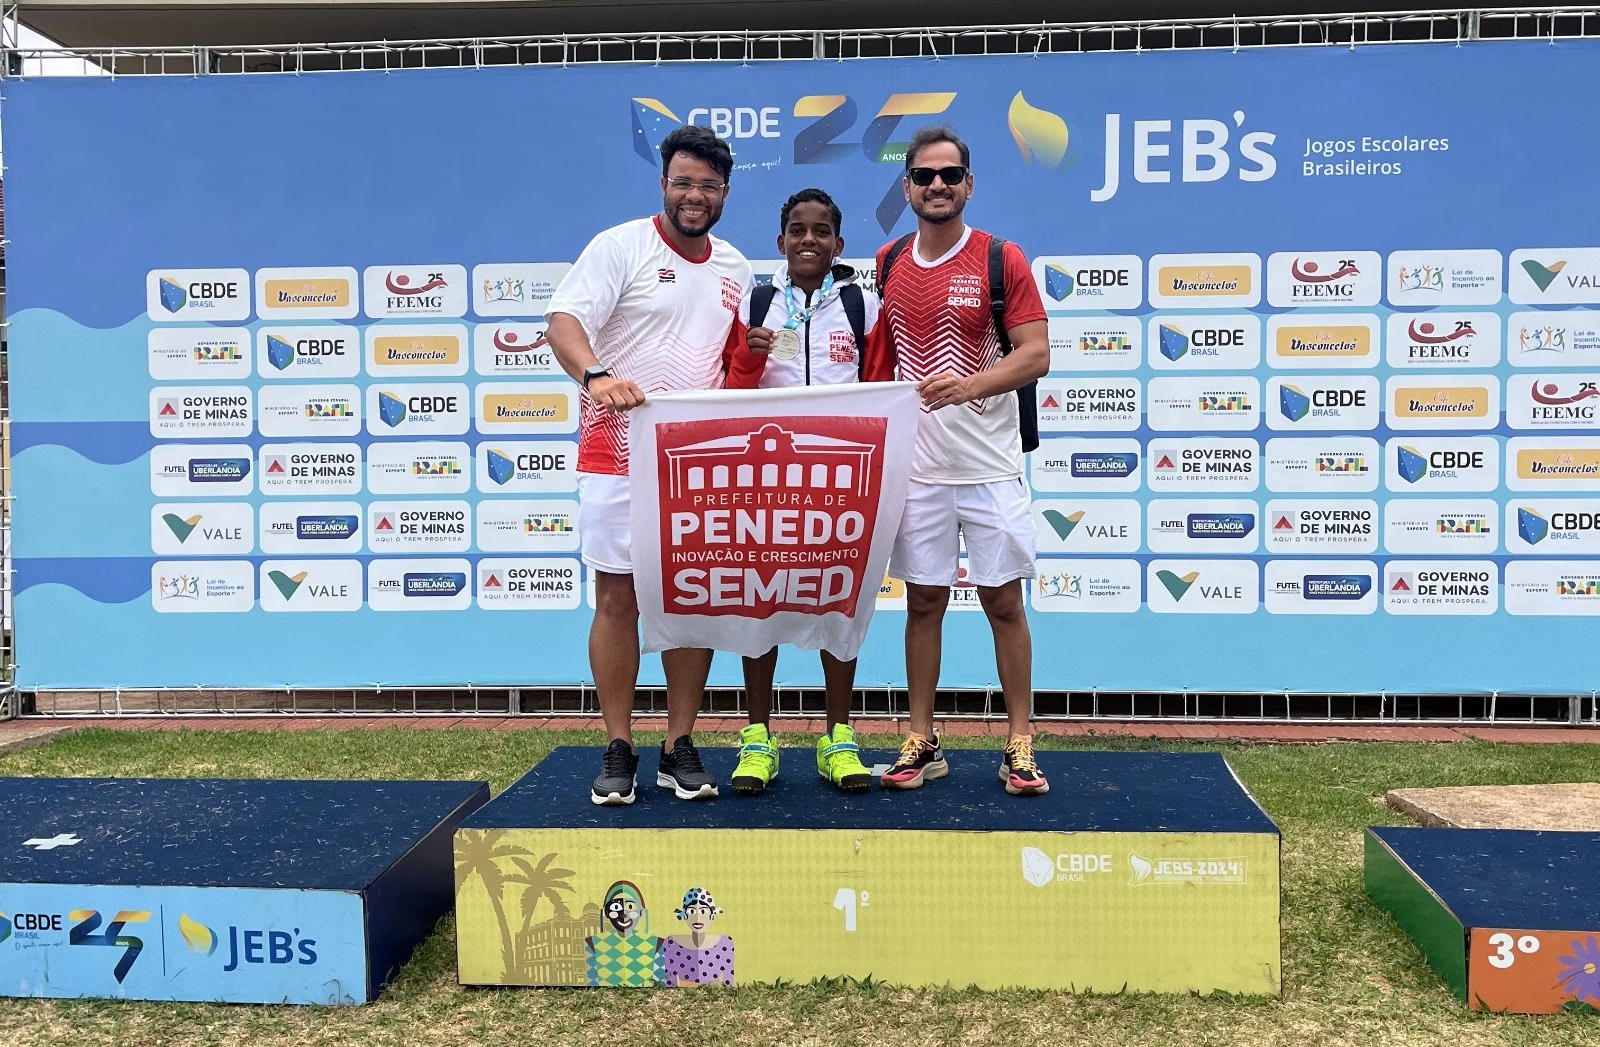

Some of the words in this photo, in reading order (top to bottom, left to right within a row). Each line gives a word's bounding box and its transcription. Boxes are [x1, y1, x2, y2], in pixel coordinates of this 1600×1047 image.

[687, 107, 781, 139] CBDE
[1304, 137, 1356, 157] Jogos
[1361, 135, 1449, 153] Escolares
[882, 153, 907, 161] ANOS
[1303, 160, 1402, 177] Brasileiros
[1339, 260, 1356, 271] 25
[429, 273, 444, 284] 25
[1076, 269, 1128, 286] CBDE
[1567, 276, 1600, 288] VAL
[189, 282, 237, 298] CBDE
[948, 286, 981, 295] PENEDO
[1076, 288, 1104, 296] BRASIL
[1292, 284, 1354, 296] FEEMG
[387, 296, 442, 308] FEEMG
[947, 296, 981, 308] SEMED
[1455, 321, 1472, 332] 25
[1192, 329, 1244, 346] CBDE
[297, 339, 345, 356] CBDE
[1191, 348, 1219, 356] BRASIL
[1408, 346, 1470, 358] FEEMG
[494, 354, 550, 366] FEEMG
[1579, 382, 1596, 393] 25
[1067, 389, 1135, 399] GOVERNO
[1313, 390, 1366, 407] CBDE
[184, 397, 247, 406] GOVERNO
[409, 396, 457, 413] CBDE
[1067, 402, 1085, 412] DE
[1090, 402, 1135, 412] MINAS
[184, 409, 201, 419] DE
[206, 409, 247, 419] MINAS
[1531, 407, 1594, 419] FEEMG
[291, 455, 355, 464] GOVERNO
[1182, 450, 1252, 459] GOVERNO
[1430, 451, 1483, 468] CBDE
[517, 454, 565, 470] CBDE
[1182, 462, 1201, 473] DE
[1206, 462, 1252, 473] MINAS
[291, 467, 308, 476] DE
[313, 467, 355, 476] MINAS
[693, 493, 813, 506] PREFEITURA
[824, 494, 846, 506] DE
[400, 512, 464, 521] GOVERNO
[1300, 511, 1371, 520] GOVERNO
[1551, 513, 1600, 530] CBDE
[400, 524, 417, 534] DE
[422, 524, 464, 534] MINAS
[671, 509, 865, 546] PENEDO
[1086, 526, 1128, 537] VALE
[1300, 524, 1320, 534] DE
[1325, 524, 1371, 534] MINAS
[203, 528, 242, 539] VALE
[672, 547, 744, 563] INOVAÇÃO
[748, 551, 757, 562] E
[761, 548, 859, 563] CRESCIMENTO
[508, 569, 573, 578] GOVERNO
[1418, 572, 1489, 582] GOVERNO
[308, 585, 348, 596] VALE
[508, 581, 526, 591] DE
[531, 581, 573, 591] MINAS
[673, 565, 854, 607] SEMED
[1418, 585, 1437, 596] DE
[1443, 585, 1489, 596] MINAS
[1200, 586, 1242, 598] VALE
[1056, 853, 1112, 873] CBDE
[1056, 873, 1086, 882] BRASIL
[14, 913, 62, 931] CBDE
[14, 931, 40, 940] BRASIL
